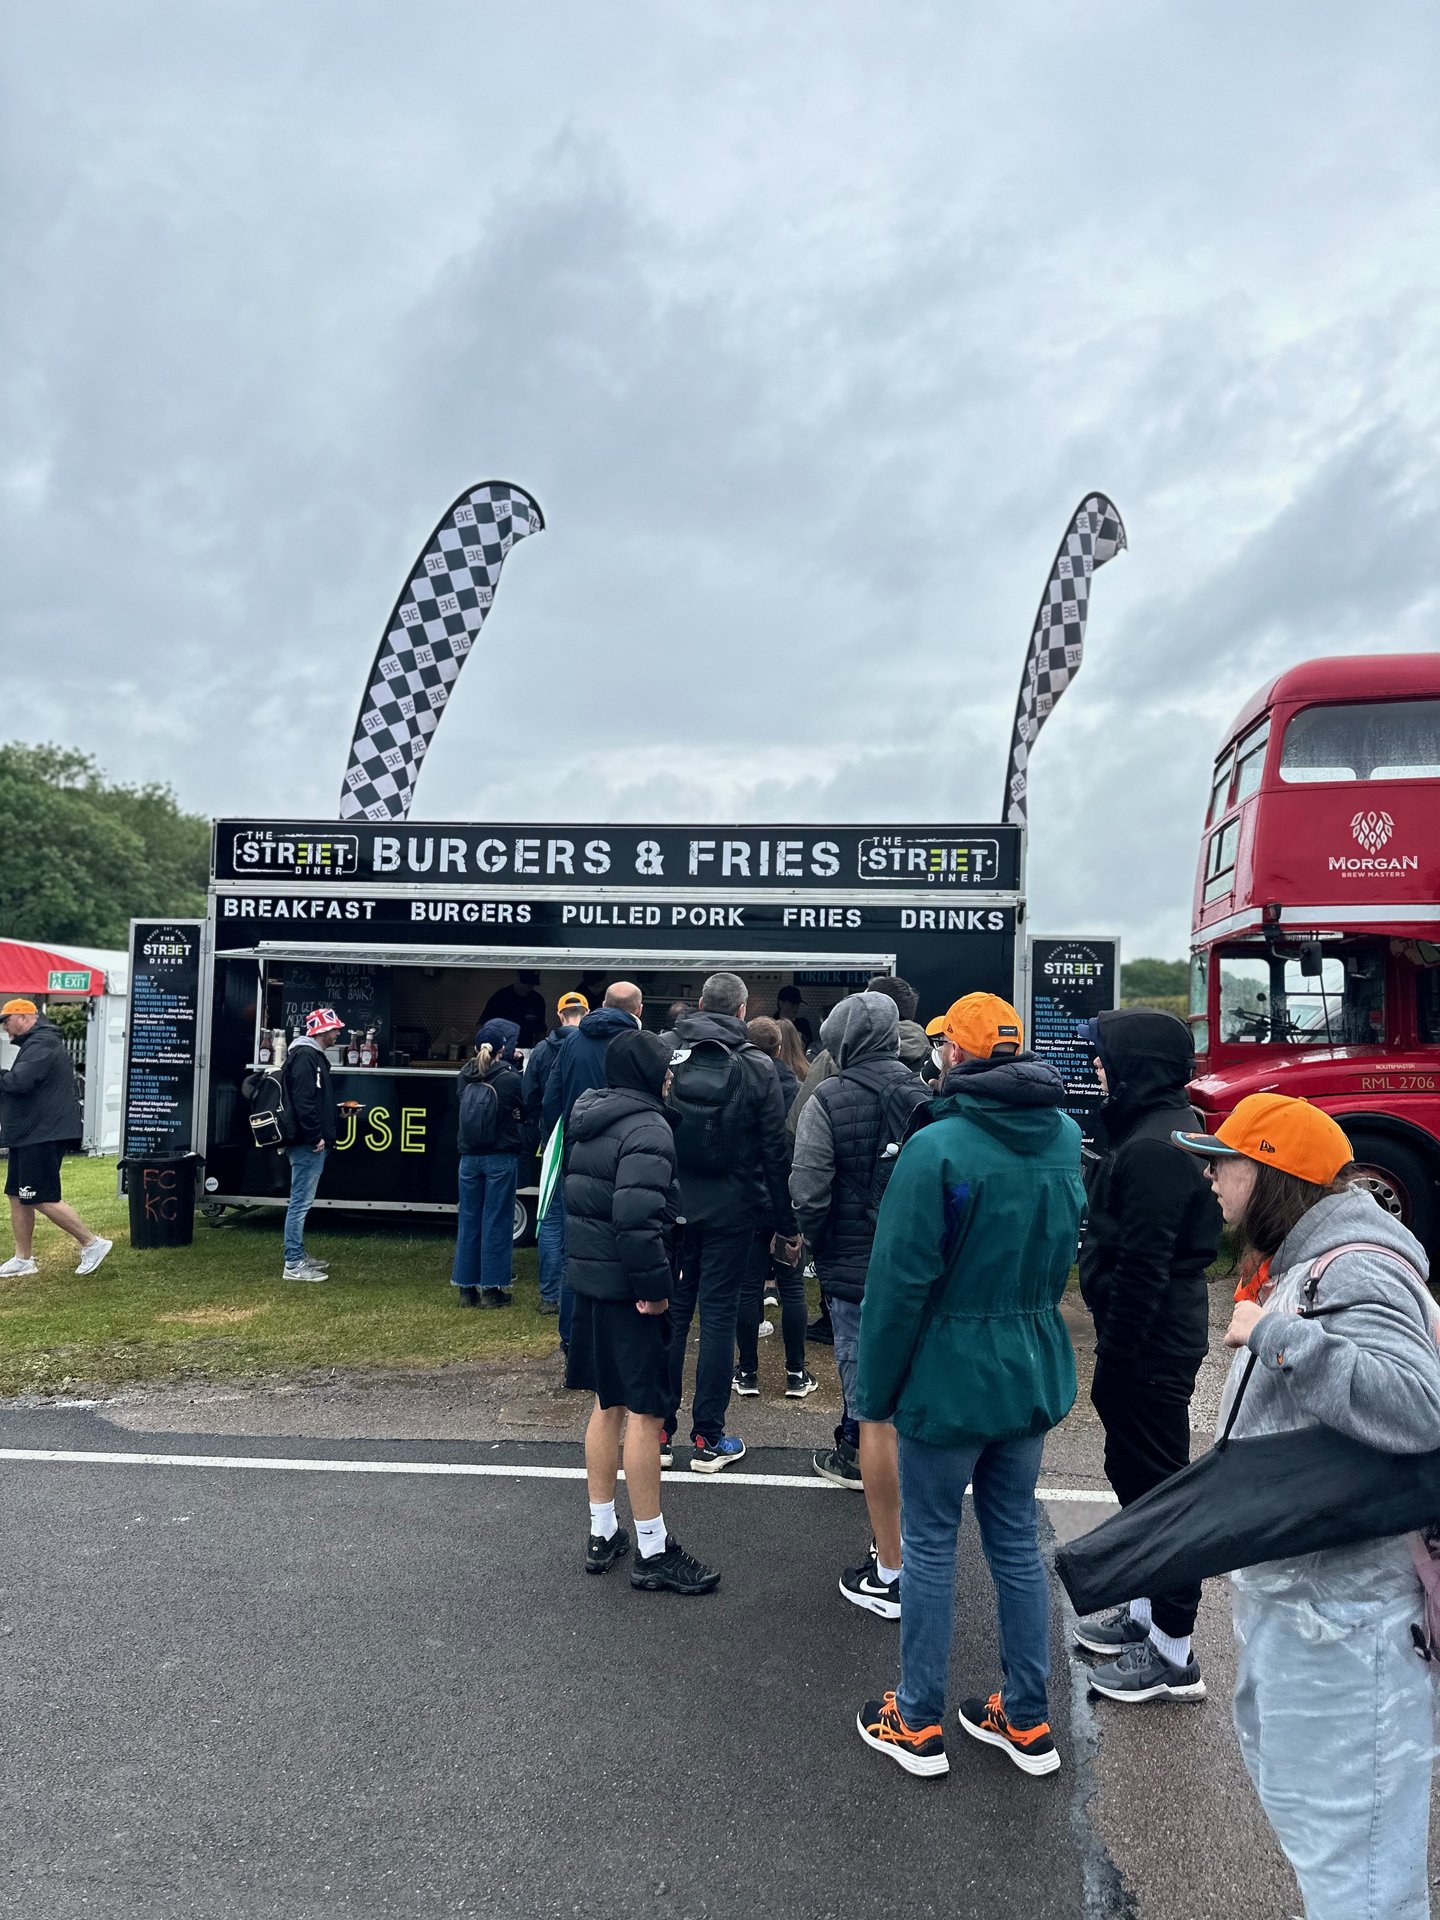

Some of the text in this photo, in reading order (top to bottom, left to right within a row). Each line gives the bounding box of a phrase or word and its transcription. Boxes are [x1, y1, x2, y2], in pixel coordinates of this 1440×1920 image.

[247, 831, 273, 840] THE
[873, 837, 902, 846] THE
[242, 841, 349, 865] STREET
[373, 837, 840, 877] BURGERS & FRIES
[868, 848, 988, 872] STREET
[1328, 856, 1418, 870] MORGAN
[295, 866, 342, 875] DINER
[928, 874, 981, 882] DINER
[224, 898, 376, 920] BREAKFAST
[411, 901, 531, 923] BURGERS
[562, 905, 745, 926] PULLED PORK
[783, 908, 862, 928] FRIES
[901, 909, 1004, 931] DRINKS
[143, 944, 192, 956] STREET
[1044, 962, 1104, 975] STREET
[64, 978, 87, 988] EXIT
[325, 977, 372, 988] DUCK GO TO
[800, 971, 871, 983] ORDER HER
[327, 987, 375, 1001] THE BANK?
[285, 1002, 298, 1014] TO
[301, 1002, 315, 1012] GET
[1362, 1076, 1435, 1090] RML 2706
[143, 1168, 176, 1191] FC
